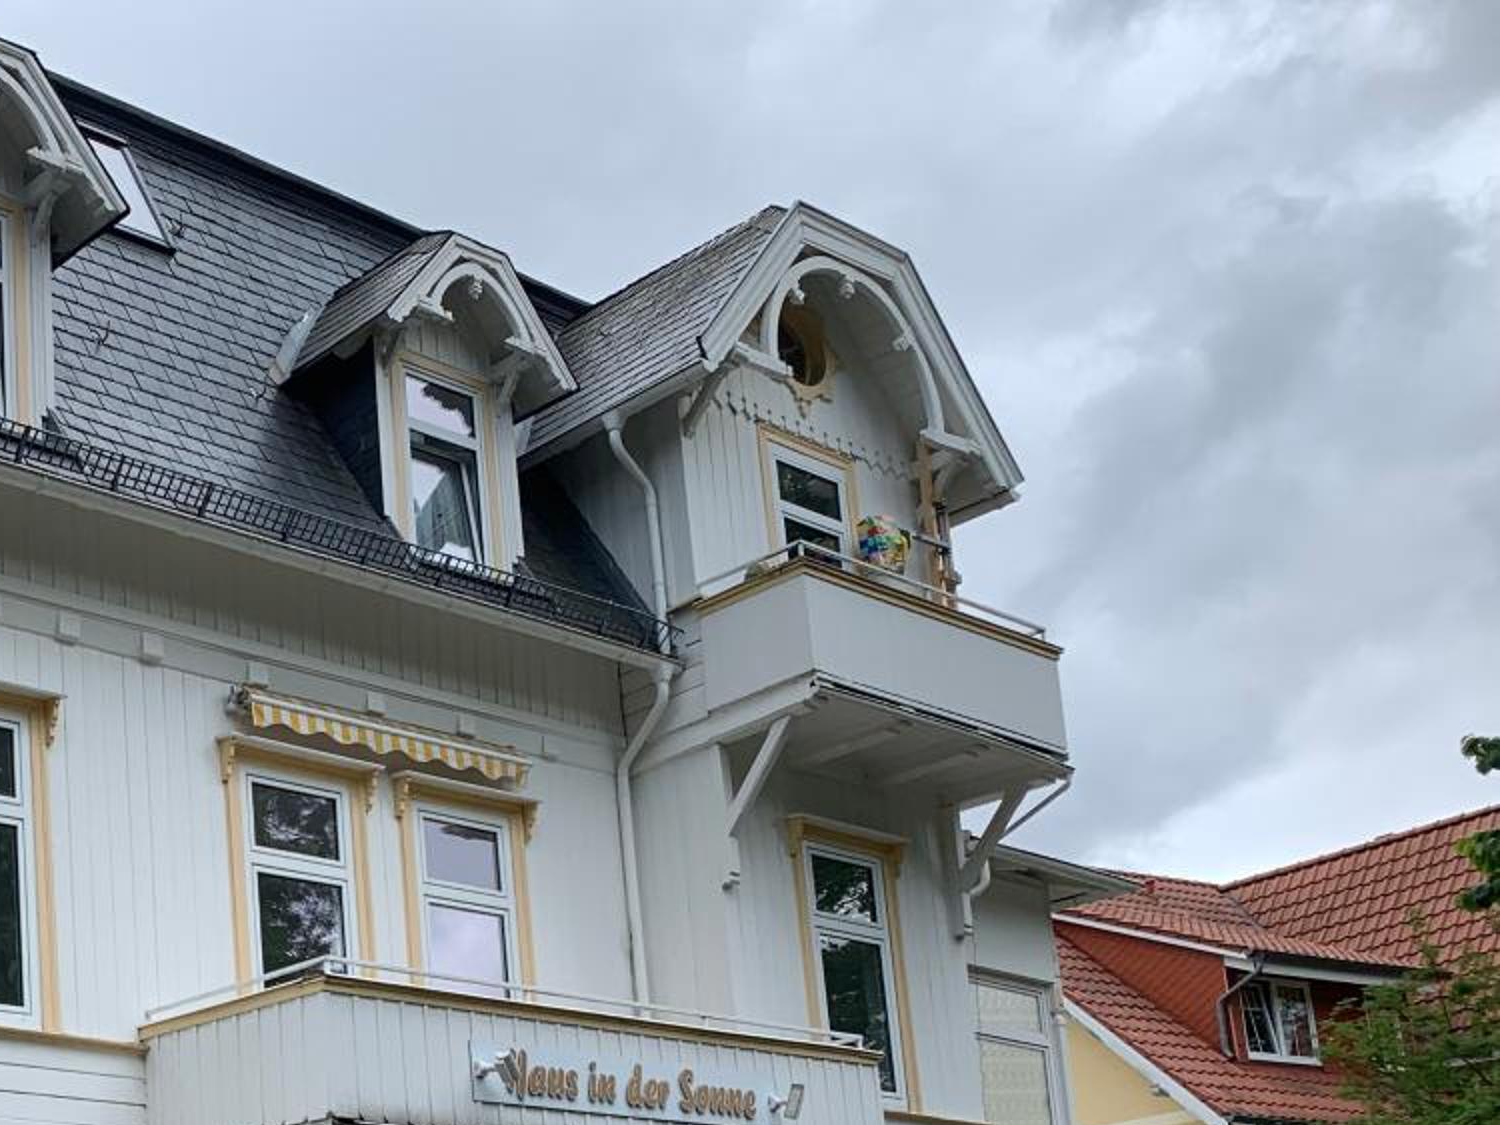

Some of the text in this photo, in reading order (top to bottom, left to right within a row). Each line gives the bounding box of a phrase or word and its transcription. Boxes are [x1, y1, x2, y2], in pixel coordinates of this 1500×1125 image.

[588, 1061, 616, 1104] in
[626, 1063, 669, 1109] der
[677, 1068, 757, 1120] Sonne
